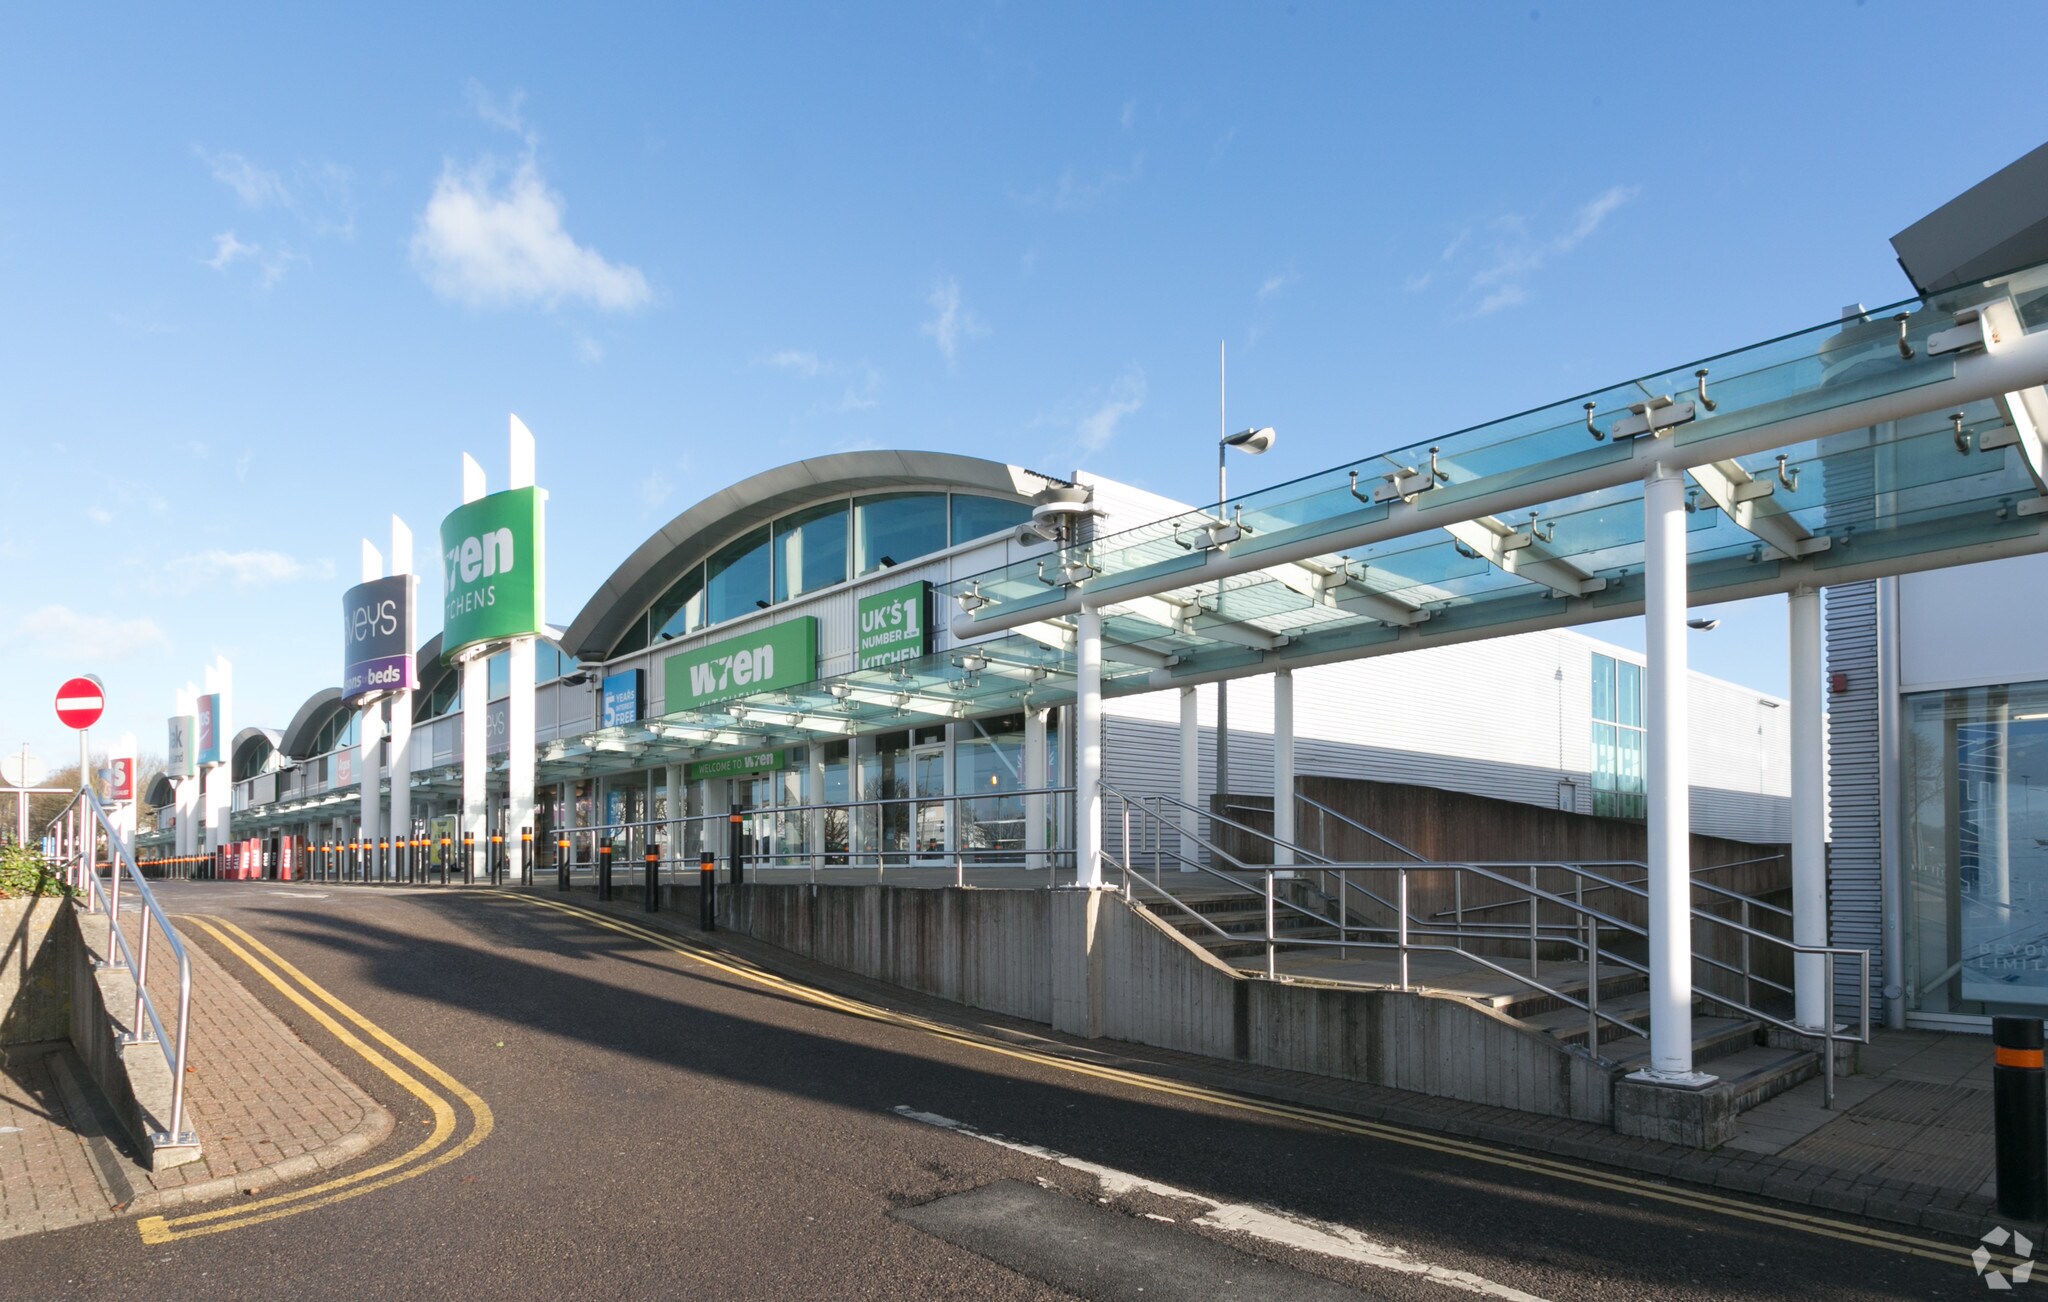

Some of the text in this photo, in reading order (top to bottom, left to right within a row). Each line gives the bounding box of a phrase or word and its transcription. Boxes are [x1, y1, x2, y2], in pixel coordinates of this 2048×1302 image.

[444, 527, 514, 598] ren
[862, 598, 920, 650] NUMBER 1
[368, 665, 400, 685] beds
[690, 644, 774, 697] wren
[616, 689, 635, 702] YEARS
[604, 695, 616, 728] 5
[615, 711, 635, 726] FREE
[699, 753, 774, 773] WELCOME TO wren
[1979, 958, 2048, 971] LIMIT
